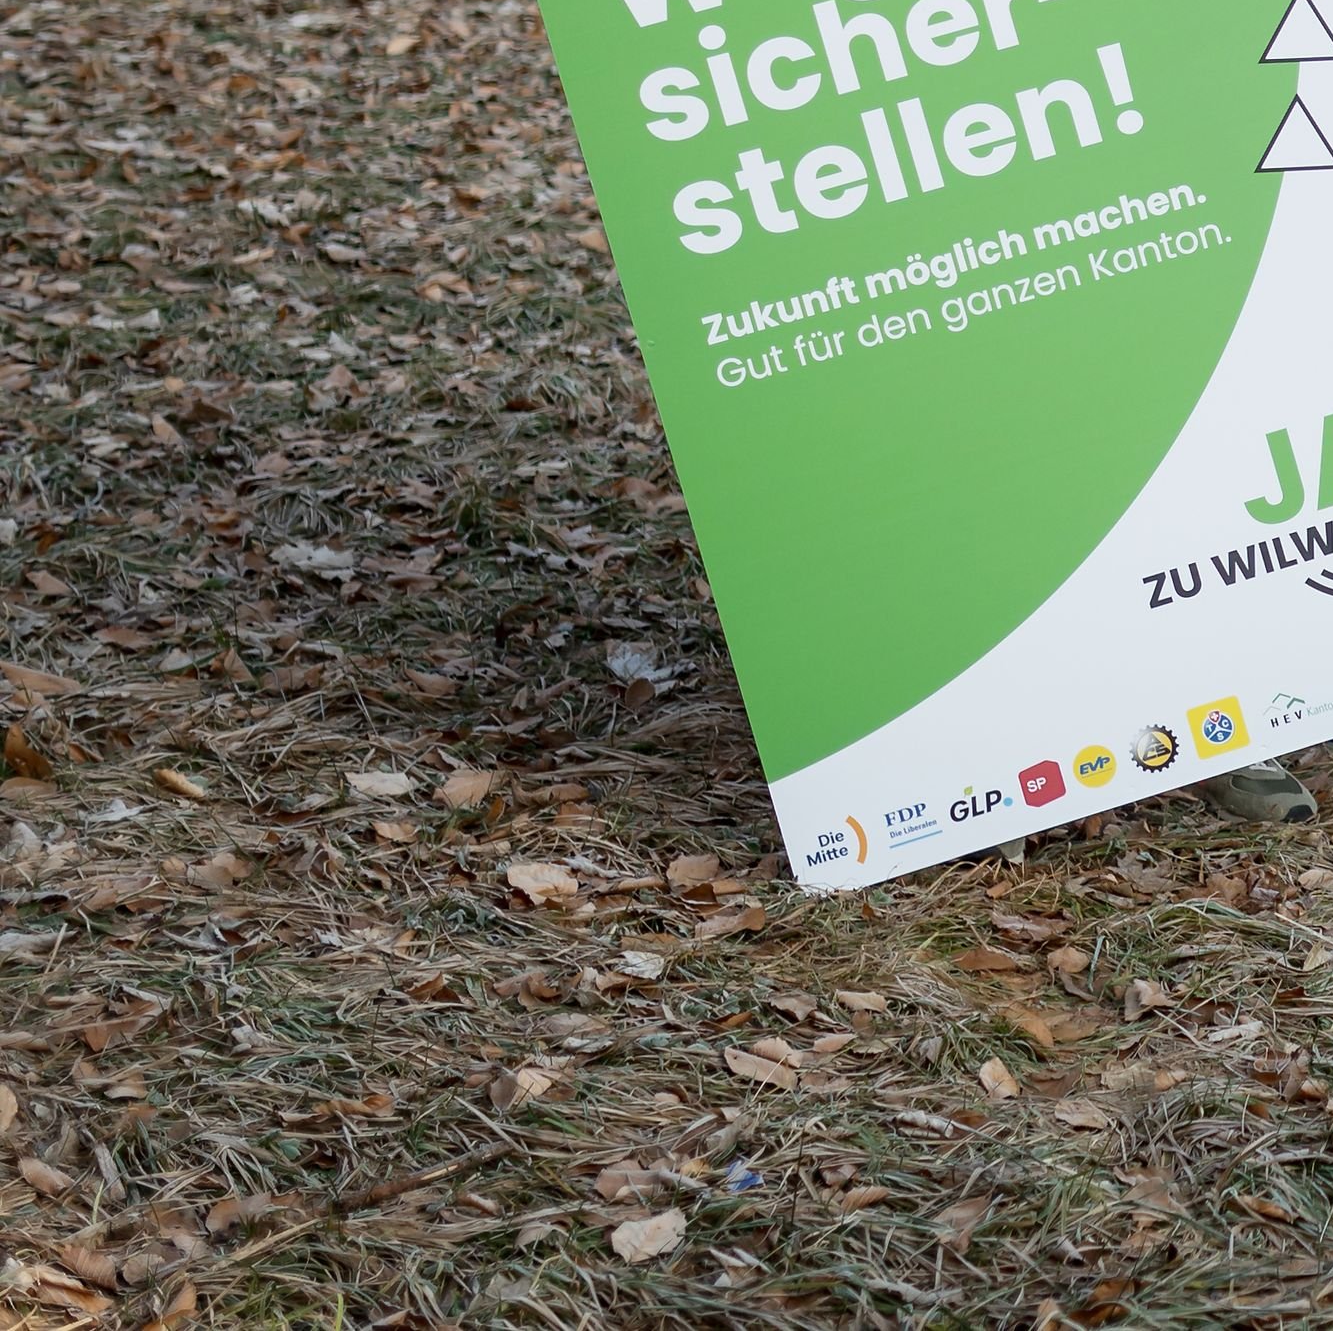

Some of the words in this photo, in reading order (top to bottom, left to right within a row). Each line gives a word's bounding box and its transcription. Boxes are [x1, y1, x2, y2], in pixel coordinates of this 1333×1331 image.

[672, 42, 1144, 254] stellen!
[701, 276, 860, 346] Zukunft
[864, 229, 1028, 291] möglich
[1033, 181, 1208, 252] machen.
[715, 345, 788, 388] Gut
[793, 327, 846, 368] für
[857, 307, 932, 349] den
[940, 262, 1081, 333] ganzen
[1088, 219, 1234, 281] Kanton.
[1142, 562, 1202, 609] ZU
[1079, 755, 1110, 776] EVP
[1026, 776, 1047, 793] SP
[883, 802, 927, 827] FDP
[817, 831, 845, 848] Die
[889, 828, 902, 839] Die
[903, 819, 937, 835] Liberalen
[806, 845, 849, 867] Mitte
